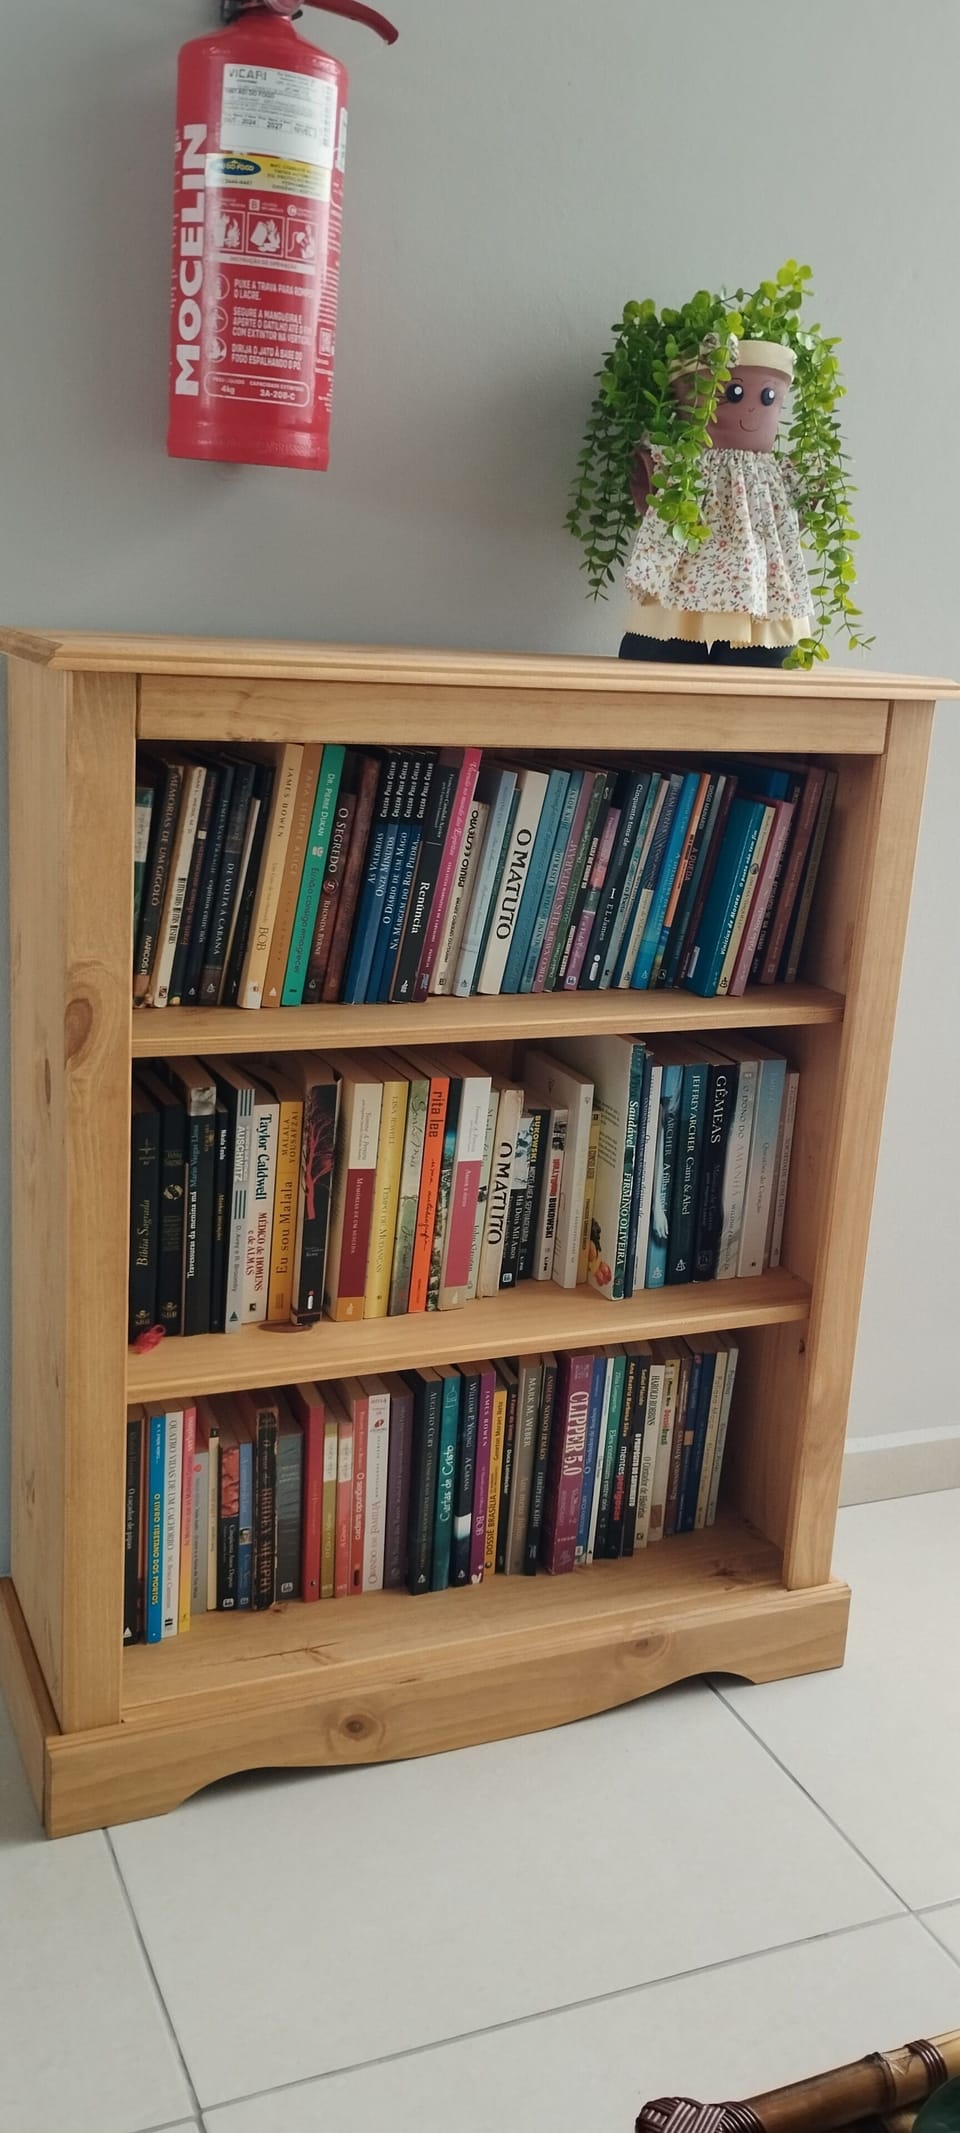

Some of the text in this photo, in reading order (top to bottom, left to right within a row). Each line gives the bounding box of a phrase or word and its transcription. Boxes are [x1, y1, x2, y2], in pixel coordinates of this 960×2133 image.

[229, 68, 267, 81] VICARI
[175, 123, 208, 397] MOCELIN
[234, 278, 251, 289] PUXE
[257, 281, 277, 292] TRAVA
[278, 283, 293, 295] PARA
[233, 306, 257, 318] SEGURE
[233, 316, 256, 328] APERTE
[263, 319, 287, 332] GATILHO
[232, 326, 247, 337] COM
[248, 327, 277, 340] EXTINTOR
[231, 352, 248, 364] FOGO
[259, 346, 274, 357] JATO
[220, 384, 236, 395] 4kg
[277, 767, 295, 838] JAMES BOWEN
[623, 784, 643, 846] Cinquenta tons de
[295, 803, 310, 842] SEMPRE
[328, 808, 349, 872] O SEGREDO
[151, 831, 170, 906] DE UM GIGOLÓ
[290, 846, 304, 875] ALICE
[685, 856, 697, 881] QUEDA
[496, 829, 532, 940] O MATUTO
[199, 879, 214, 943] espíritos entre nós
[213, 863, 234, 955] DE VOLTA CABANA
[318, 900, 331, 930] RHONDA
[411, 881, 431, 934] Renúncia
[256, 927, 273, 951] BOB
[600, 918, 612, 941] James
[141, 936, 153, 966] MARCOS
[429, 1091, 444, 1137] rita lee
[626, 1100, 639, 1148] Saudável
[687, 1075, 701, 1152] JEFFREY ARCHER
[711, 1075, 729, 1144] GÊMEAS
[530, 1115, 542, 1162] BUKOWSKI
[664, 1117, 675, 1155] ARCHER
[235, 1126, 246, 1182] AUSCHWITZ
[255, 1114, 272, 1200] Taylor Caldwell
[487, 1142, 513, 1245] O MATUTO
[662, 1171, 671, 1191] filha
[681, 1157, 694, 1215] Caim & Abel
[190, 1192, 197, 1202] má
[276, 1181, 293, 1273] Eu sou Malala
[510, 1195, 525, 1259] Há Dois Mil Anos
[545, 1198, 557, 1239] BUKOWSKI
[616, 1172, 632, 1265] FIRMINO OLIVEIRA
[188, 1231, 196, 1239] da
[247, 1236, 255, 1245] de
[187, 1241, 195, 1278] Travessuras
[245, 1246, 256, 1275] ALMAS
[254, 1212, 268, 1291] MÉDICO de HOMENS
[468, 1383, 476, 1412] WILLIAM
[626, 1374, 634, 1397] Beatriz
[647, 1375, 661, 1426] HAROLD ROBBINS
[427, 1392, 437, 1447] AUGUSTO CURY
[524, 1378, 537, 1448] MARK M. WEBER
[565, 1391, 590, 1451] CLIPPER
[589, 1408, 597, 1429] Sonhos
[624, 1398, 632, 1421] Barbosa
[466, 1423, 474, 1448] YOUNG
[493, 1439, 501, 1461] Geneton
[585, 1438, 594, 1463] Vendedor
[563, 1455, 583, 1476] 5.0
[584, 1466, 591, 1474] O
[604, 1444, 614, 1479] continuam
[640, 1462, 651, 1486] Contador
[167, 1420, 177, 1550] QUATRO VIDAS DE UM CACHORRO
[440, 1445, 453, 1521] Cartas de Cristo
[463, 1464, 471, 1491] CABANA
[602, 1480, 612, 1497] entre
[126, 1496, 134, 1521] caçador
[354, 1481, 363, 1513] segundo
[487, 1495, 497, 1527] BRASÍLIA
[600, 1498, 608, 1510] nós
[638, 1495, 647, 1519] Histórias
[354, 1514, 362, 1540] suspiro
[475, 1516, 485, 1535] BOB
